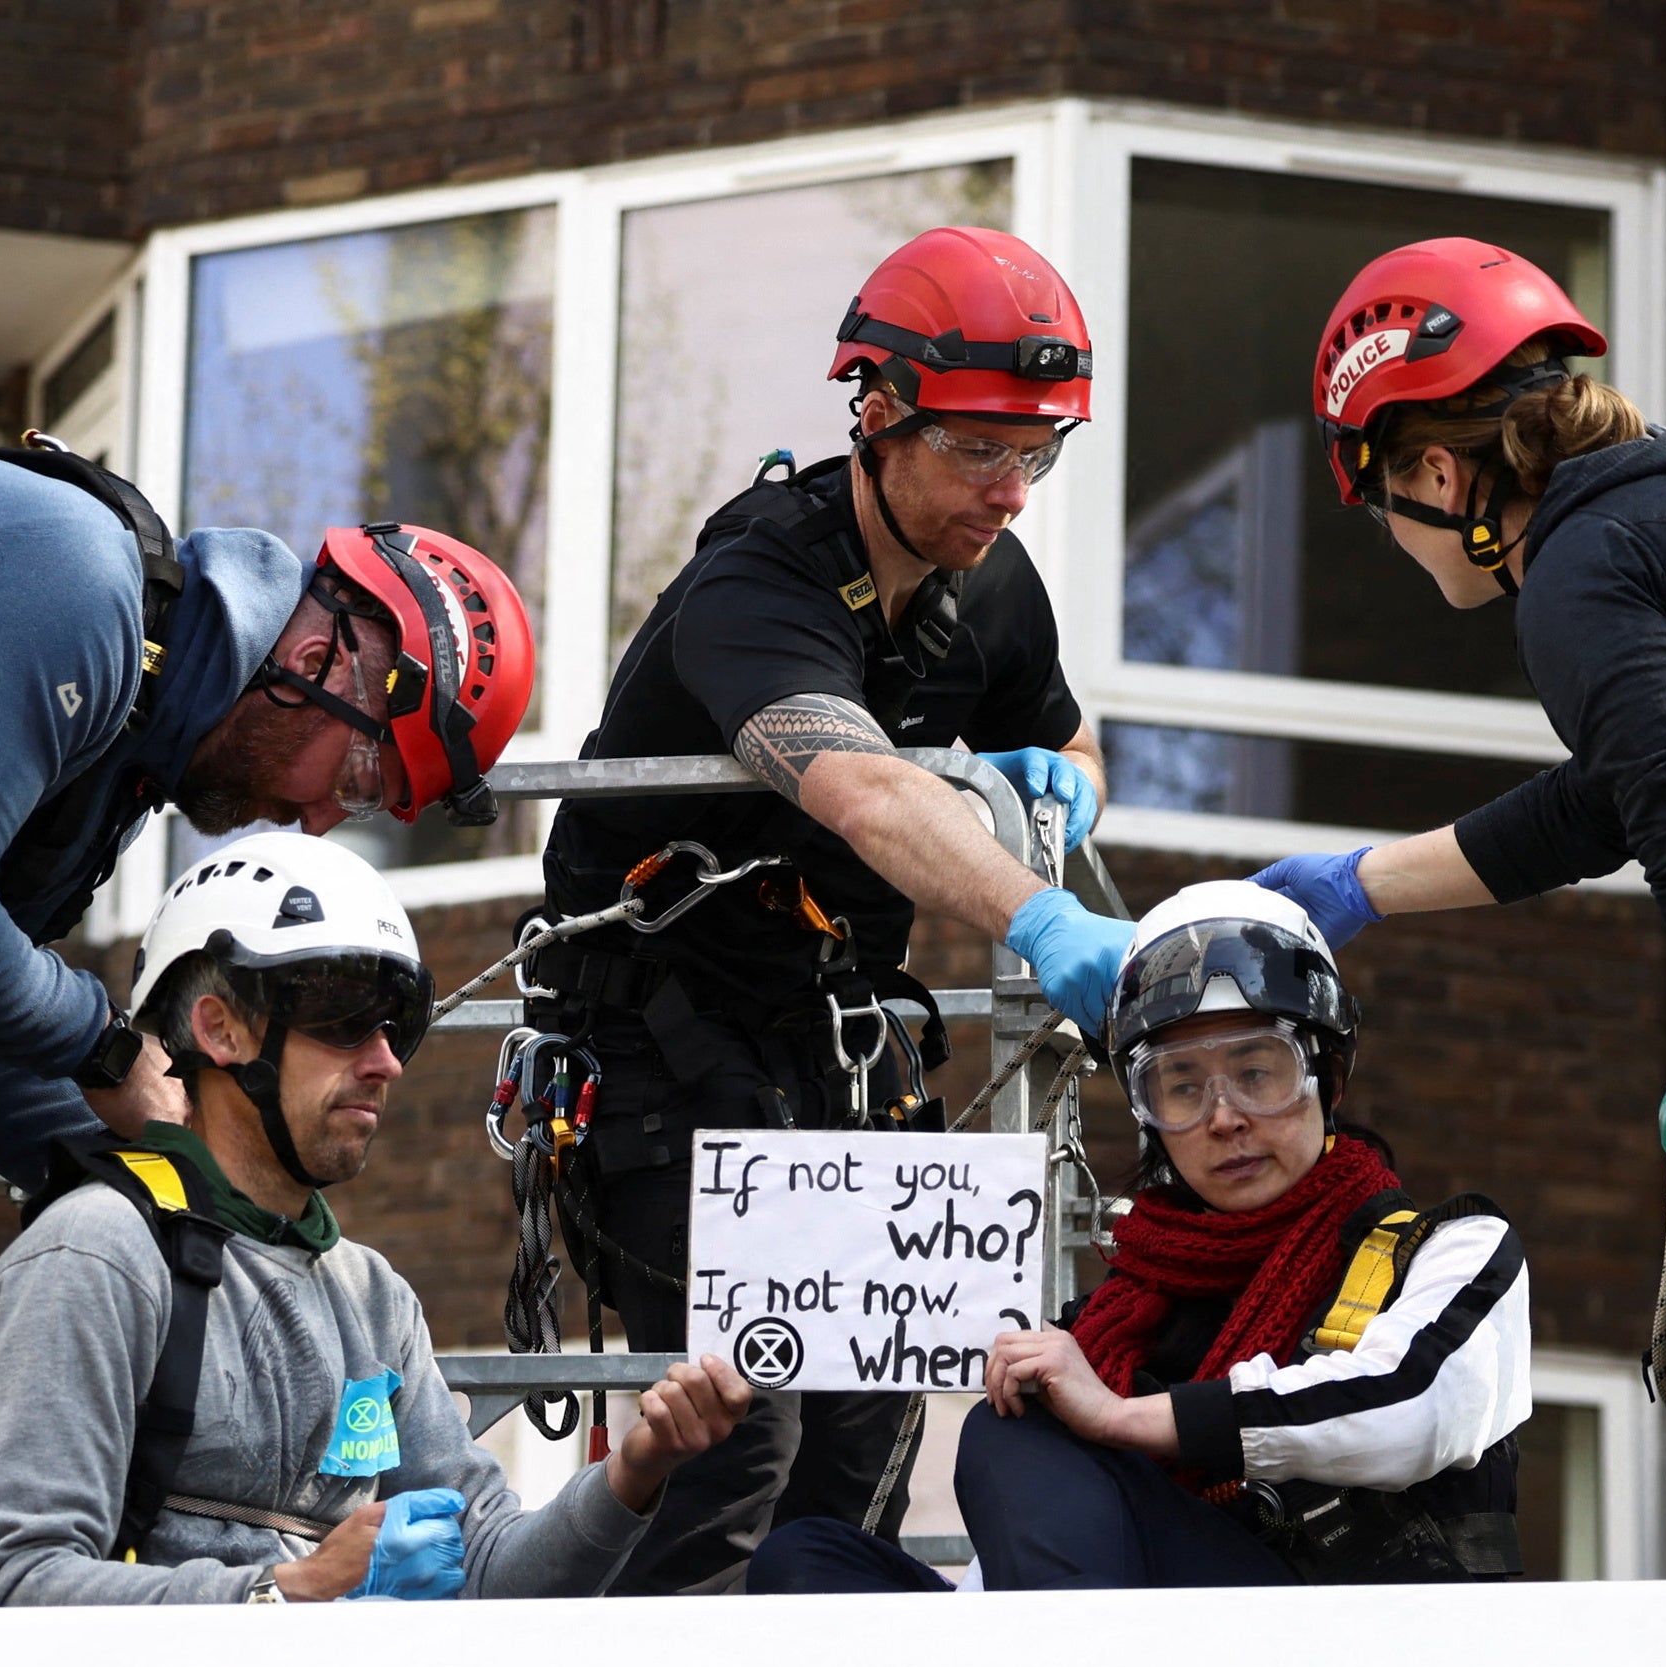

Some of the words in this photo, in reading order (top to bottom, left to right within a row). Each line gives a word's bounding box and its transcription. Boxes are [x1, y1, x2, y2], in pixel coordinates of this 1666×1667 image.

[1425, 312, 1451, 332] PETZL
[1329, 333, 1391, 404] POLICE
[430, 624, 454, 684] PETZL
[289, 897, 313, 905] VERTEX
[296, 904, 313, 912] VENT
[699, 1141, 769, 1218] If
[789, 1152, 864, 1193] not
[891, 1163, 981, 1211] you,
[886, 1188, 1043, 1284] who?
[693, 1269, 748, 1334] If
[766, 1269, 845, 1314] not
